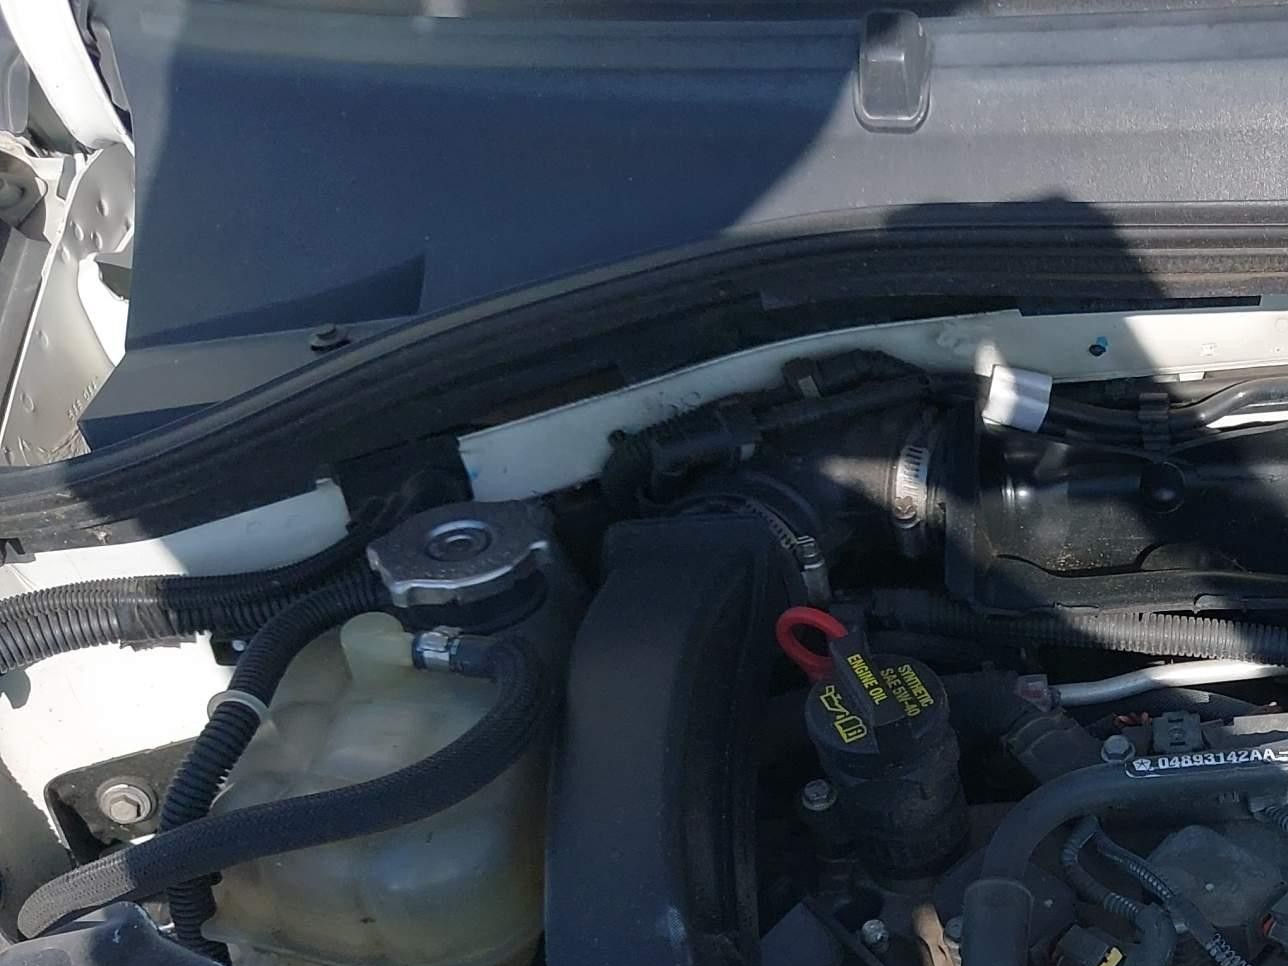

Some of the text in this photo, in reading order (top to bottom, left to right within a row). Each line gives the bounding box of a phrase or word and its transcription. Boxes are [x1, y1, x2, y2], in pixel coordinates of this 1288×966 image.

[847, 654, 888, 705] ENGINE OIL
[880, 668, 921, 717] SAE 5W-40
[898, 664, 934, 707] SYNTHETIC
